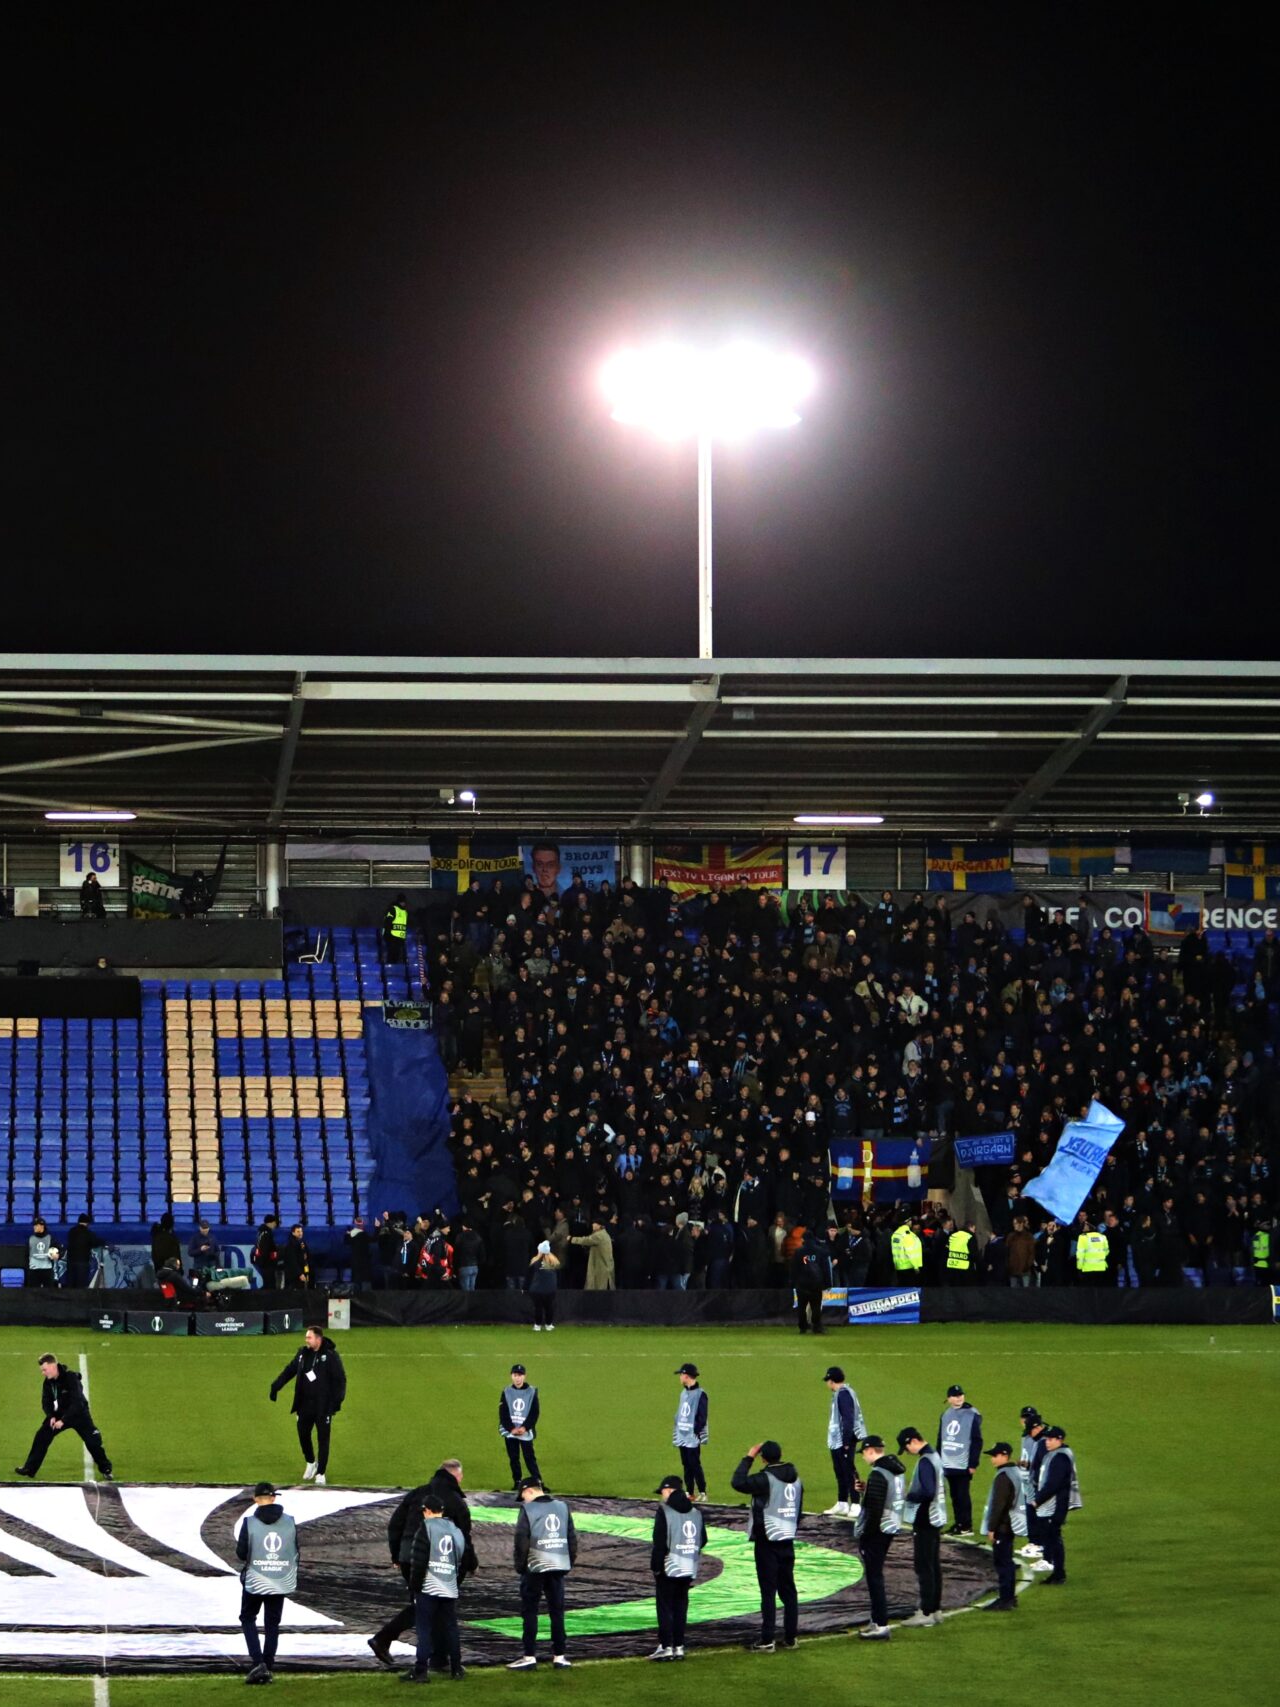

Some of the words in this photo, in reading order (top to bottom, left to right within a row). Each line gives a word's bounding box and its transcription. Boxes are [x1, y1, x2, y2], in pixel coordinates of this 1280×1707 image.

[67, 841, 111, 873] 16
[494, 857, 518, 869] TOUR
[796, 843, 838, 876] 17
[754, 870, 778, 880] TOUR
